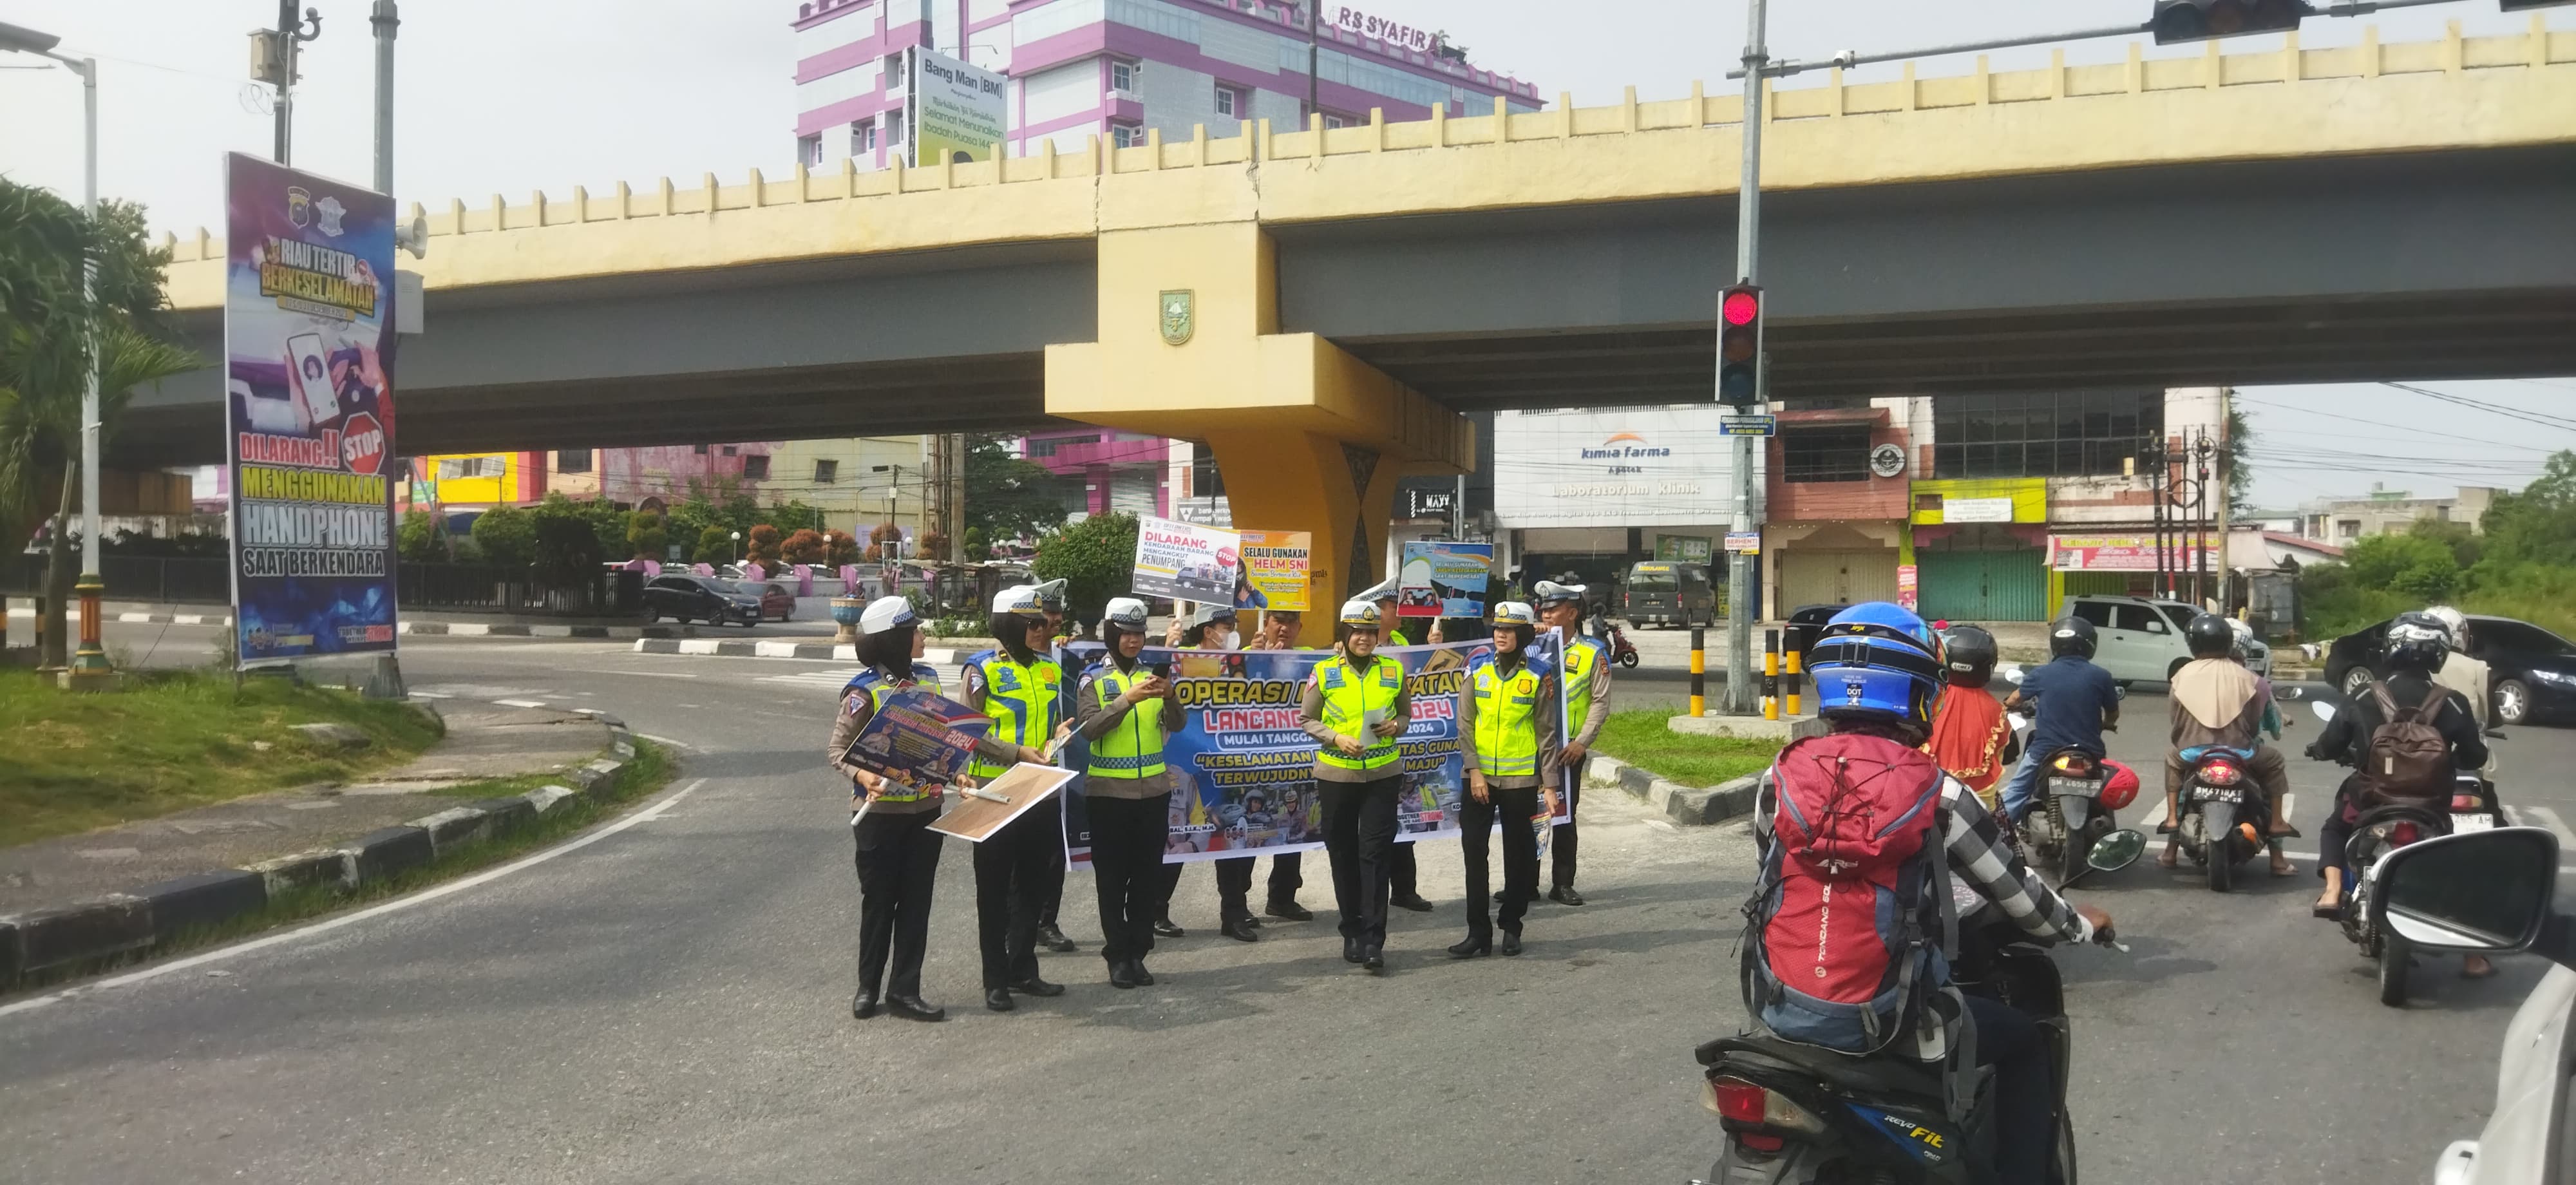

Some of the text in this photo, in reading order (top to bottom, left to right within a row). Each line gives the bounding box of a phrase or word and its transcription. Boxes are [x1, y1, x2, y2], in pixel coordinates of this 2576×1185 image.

[1340, 6, 1363, 29] RS
[925, 59, 952, 84] Bang
[956, 70, 978, 90] Man
[980, 76, 1003, 99] [BM]
[925, 106, 1004, 139] Selamat Menunaikan
[925, 122, 994, 149] Ibadah Puasa 144
[281, 238, 356, 278] RIAU TERTIB
[261, 263, 374, 310] BERKESELAMATAN
[344, 430, 383, 460] STOP
[1581, 446, 1670, 459] kimia farma
[1607, 466, 1642, 475] Apotek
[242, 466, 386, 505] MENGGUNAKAN
[1551, 482, 1649, 497] Laboratorium
[243, 504, 388, 547] HANDPHONE
[1144, 542, 1214, 556] KENDARAAN BARANG
[1145, 531, 1208, 549] DILARANG
[244, 549, 385, 576] SAAT BERKENDARA
[1142, 554, 1186, 568] PENUMPANG
[1143, 548, 1189, 558] MENGANGKUT
[1217, 551, 1236, 563] STOP
[1244, 547, 1307, 558] SELALU GUNAKAN
[1254, 559, 1307, 569] HELM SNI
[1175, 680, 1291, 705] OPERASI
[1406, 723, 1434, 734] 2024
[945, 730, 974, 751] 2024
[1224, 734, 1264, 745] MULAI
[1419, 811, 1443, 822] STRONG
[1817, 906, 1829, 962] TONDANO
[1884, 1115, 1944, 1149] REVO Fit
